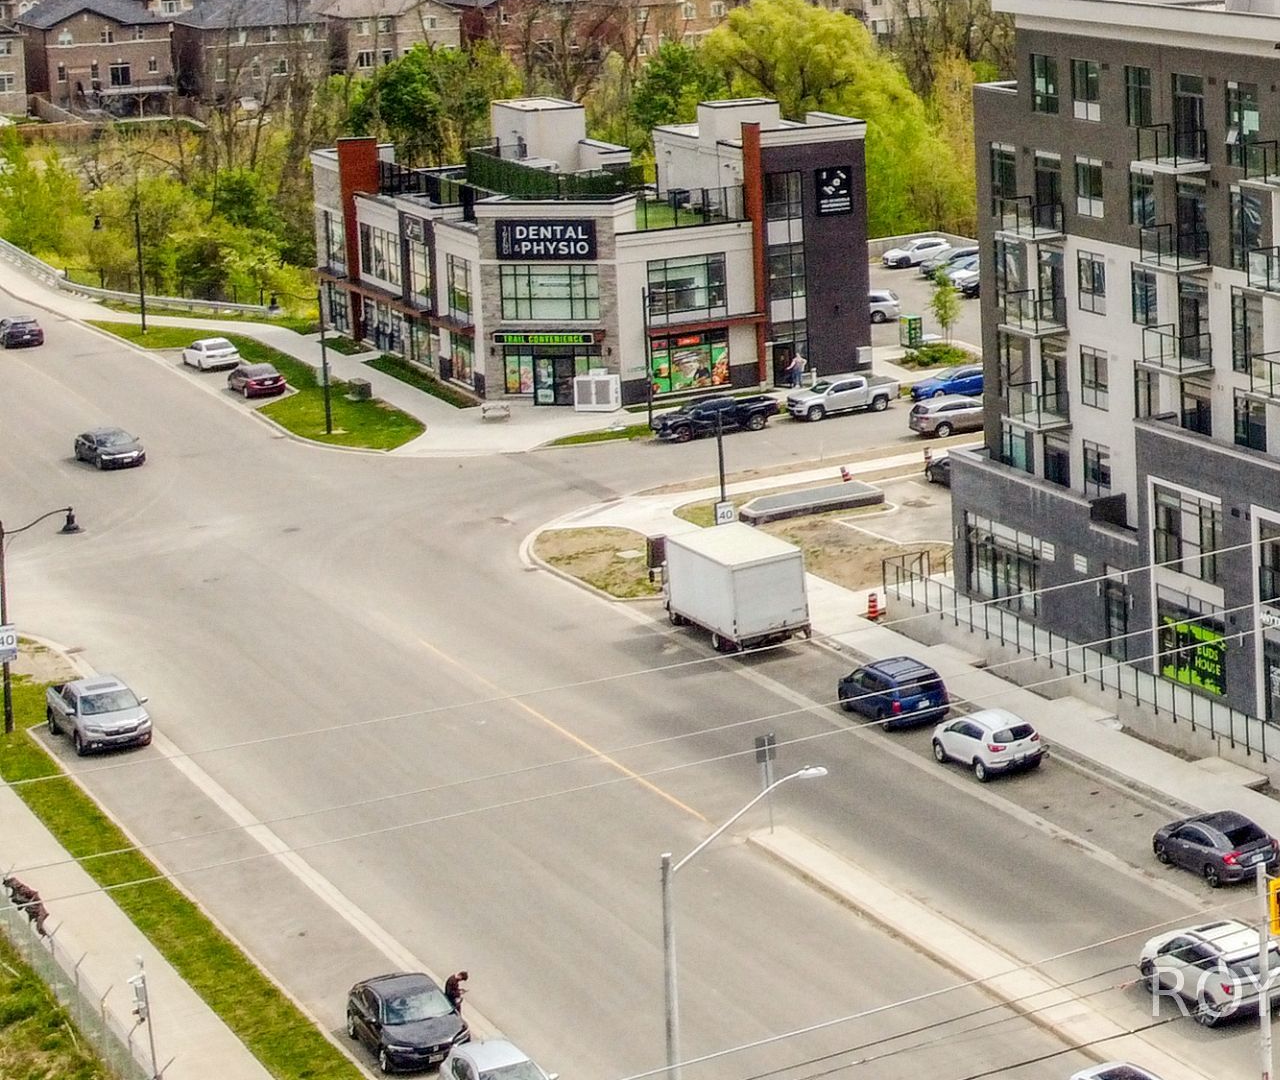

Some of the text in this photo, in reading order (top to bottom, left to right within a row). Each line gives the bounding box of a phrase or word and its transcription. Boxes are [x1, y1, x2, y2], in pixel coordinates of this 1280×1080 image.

[515, 226, 589, 239] DENTAL
[521, 242, 590, 255] PHYSIO
[720, 510, 733, 520] 40
